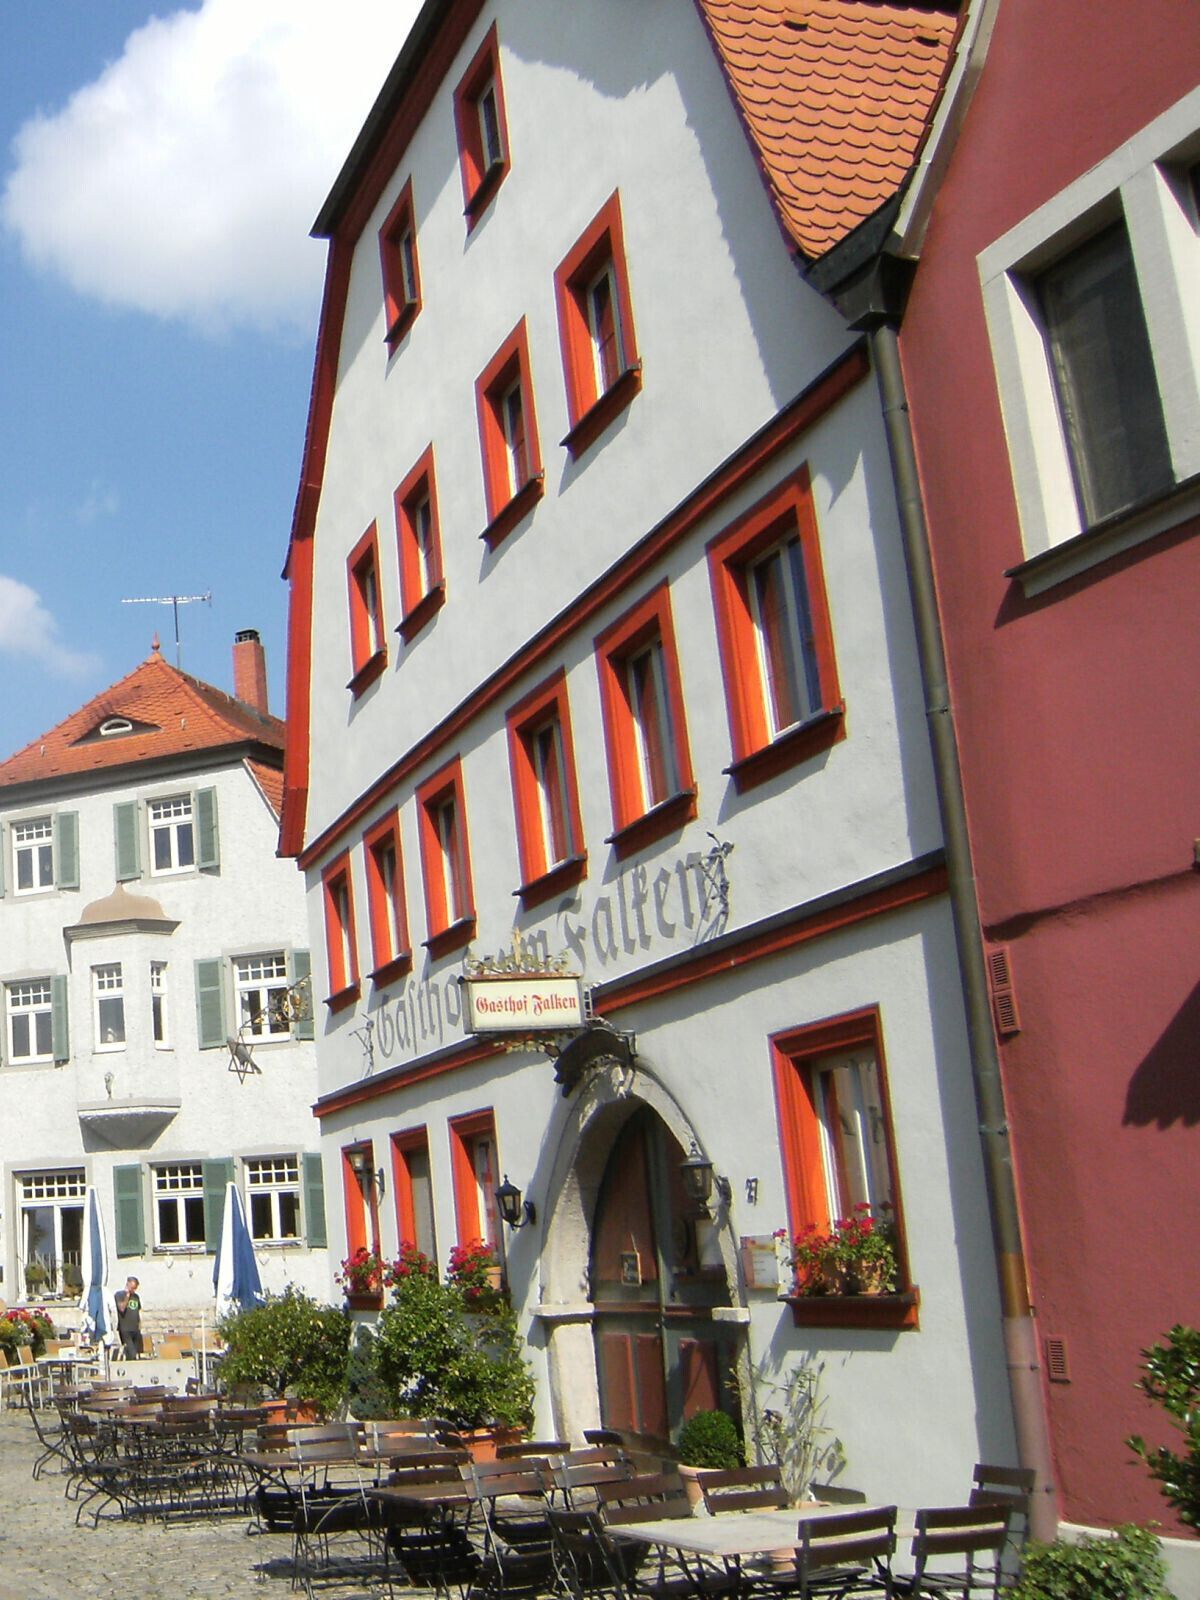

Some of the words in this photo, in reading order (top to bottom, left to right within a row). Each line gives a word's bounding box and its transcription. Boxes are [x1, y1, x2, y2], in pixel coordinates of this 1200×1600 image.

[557, 852, 712, 974] Falken
[476, 994, 528, 1015] Gasthof
[531, 993, 577, 1016] Falken
